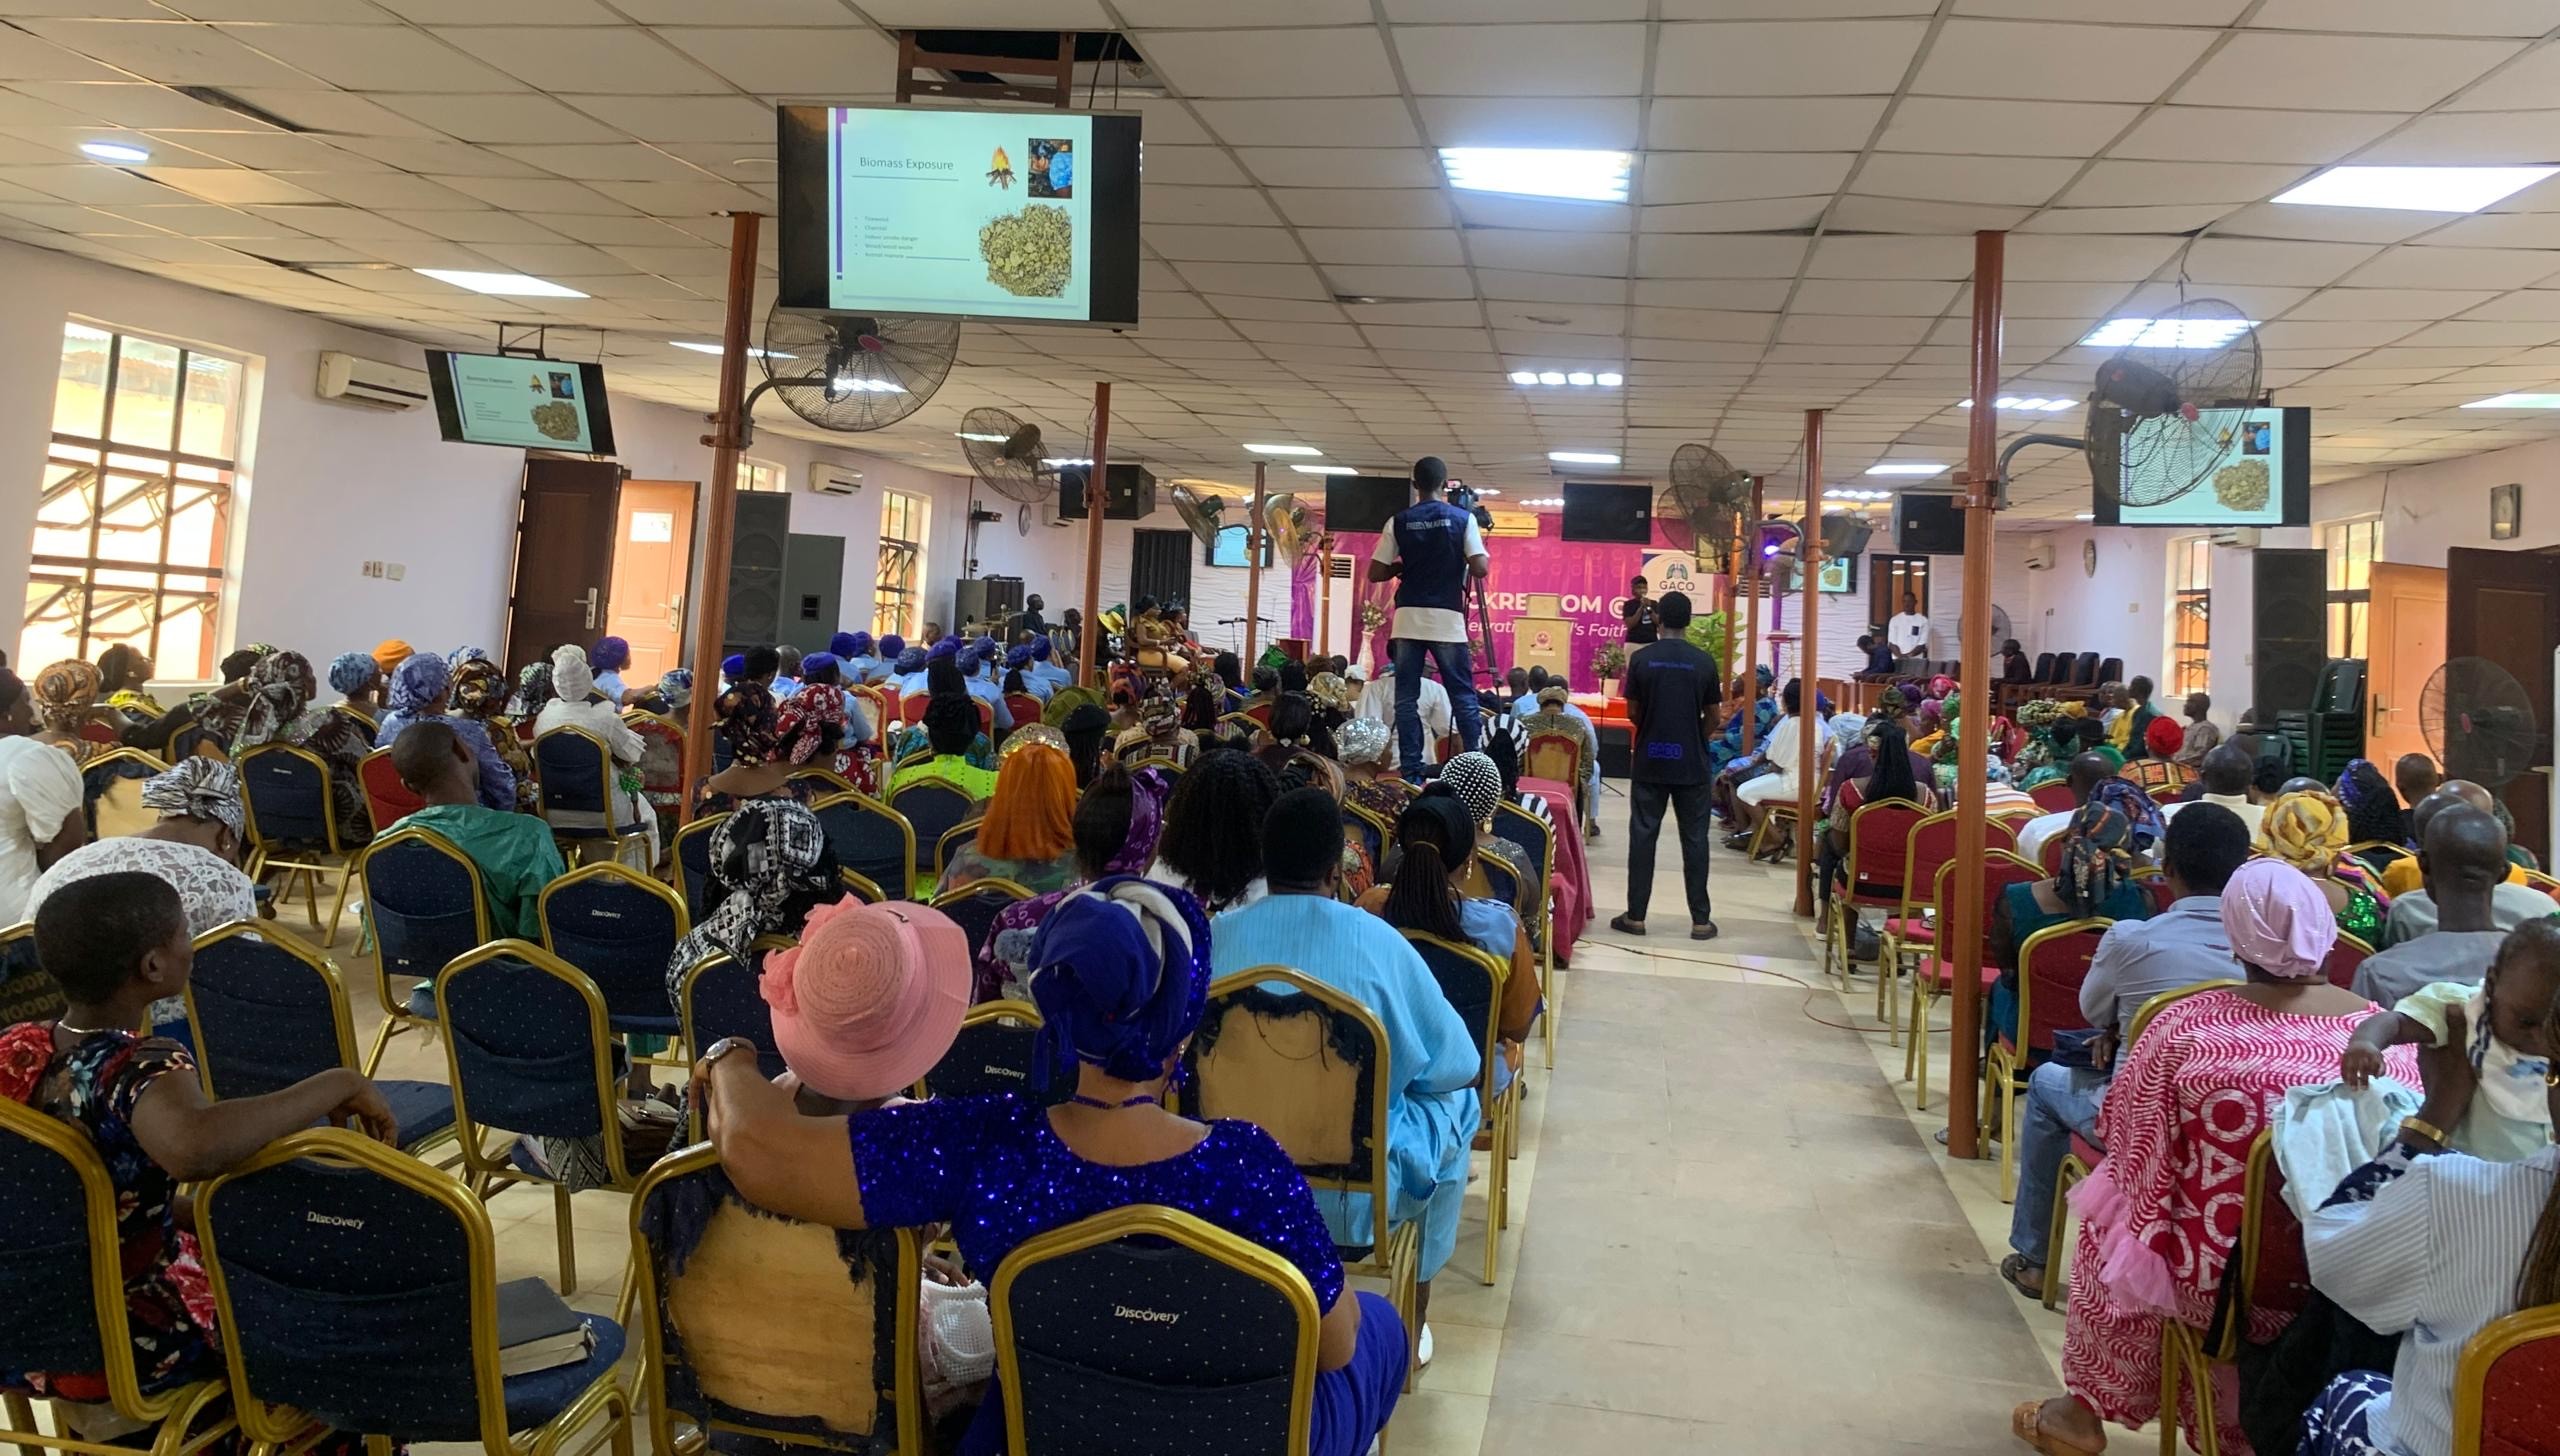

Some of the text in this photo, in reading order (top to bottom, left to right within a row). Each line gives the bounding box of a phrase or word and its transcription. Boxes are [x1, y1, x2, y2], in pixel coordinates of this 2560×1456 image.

[859, 156, 954, 170] Biomass Exposure
[1659, 580, 1696, 592] GACO
[1114, 1305, 1179, 1324] Discovery
